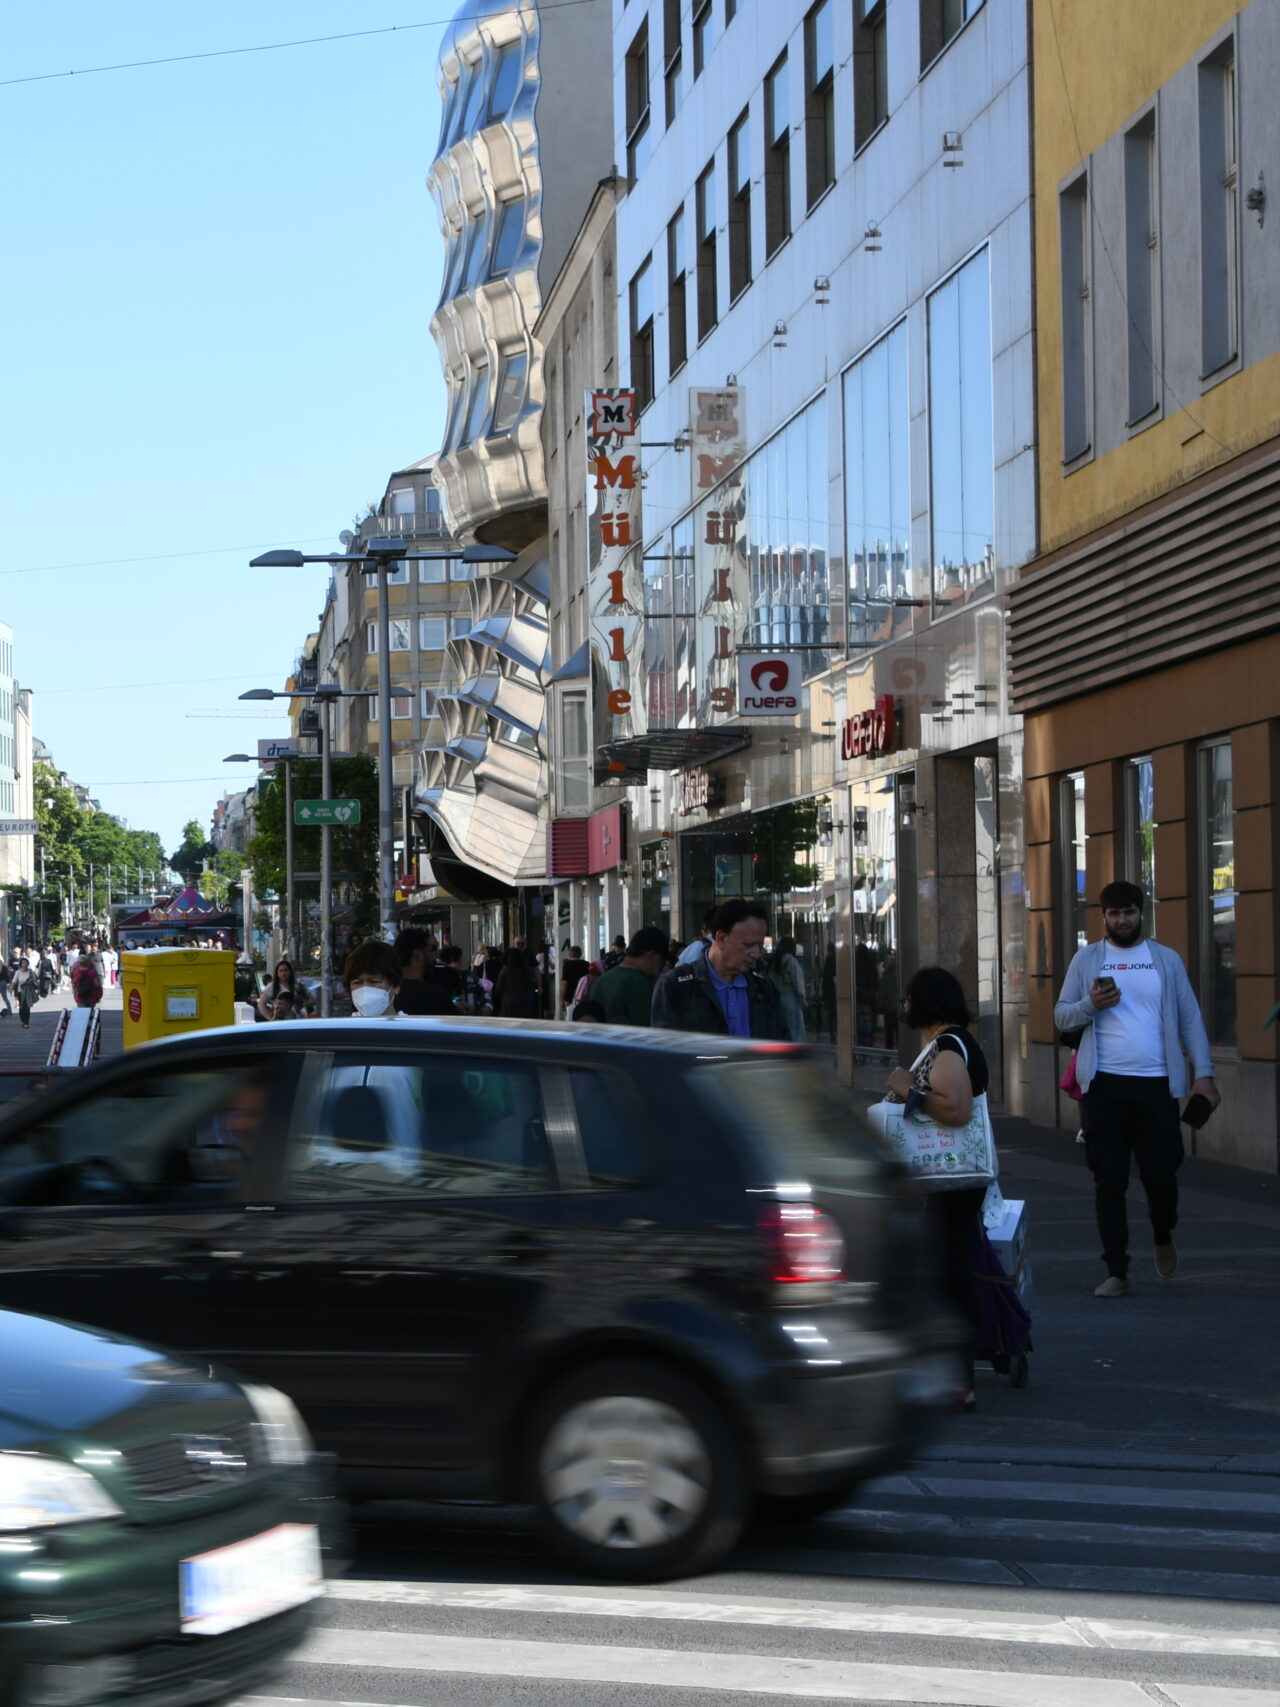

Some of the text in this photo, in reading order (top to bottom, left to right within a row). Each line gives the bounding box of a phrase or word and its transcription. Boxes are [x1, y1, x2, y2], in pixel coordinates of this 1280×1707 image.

[602, 405, 626, 424] M
[593, 454, 637, 772] Mülle
[744, 696, 797, 709] ruefa
